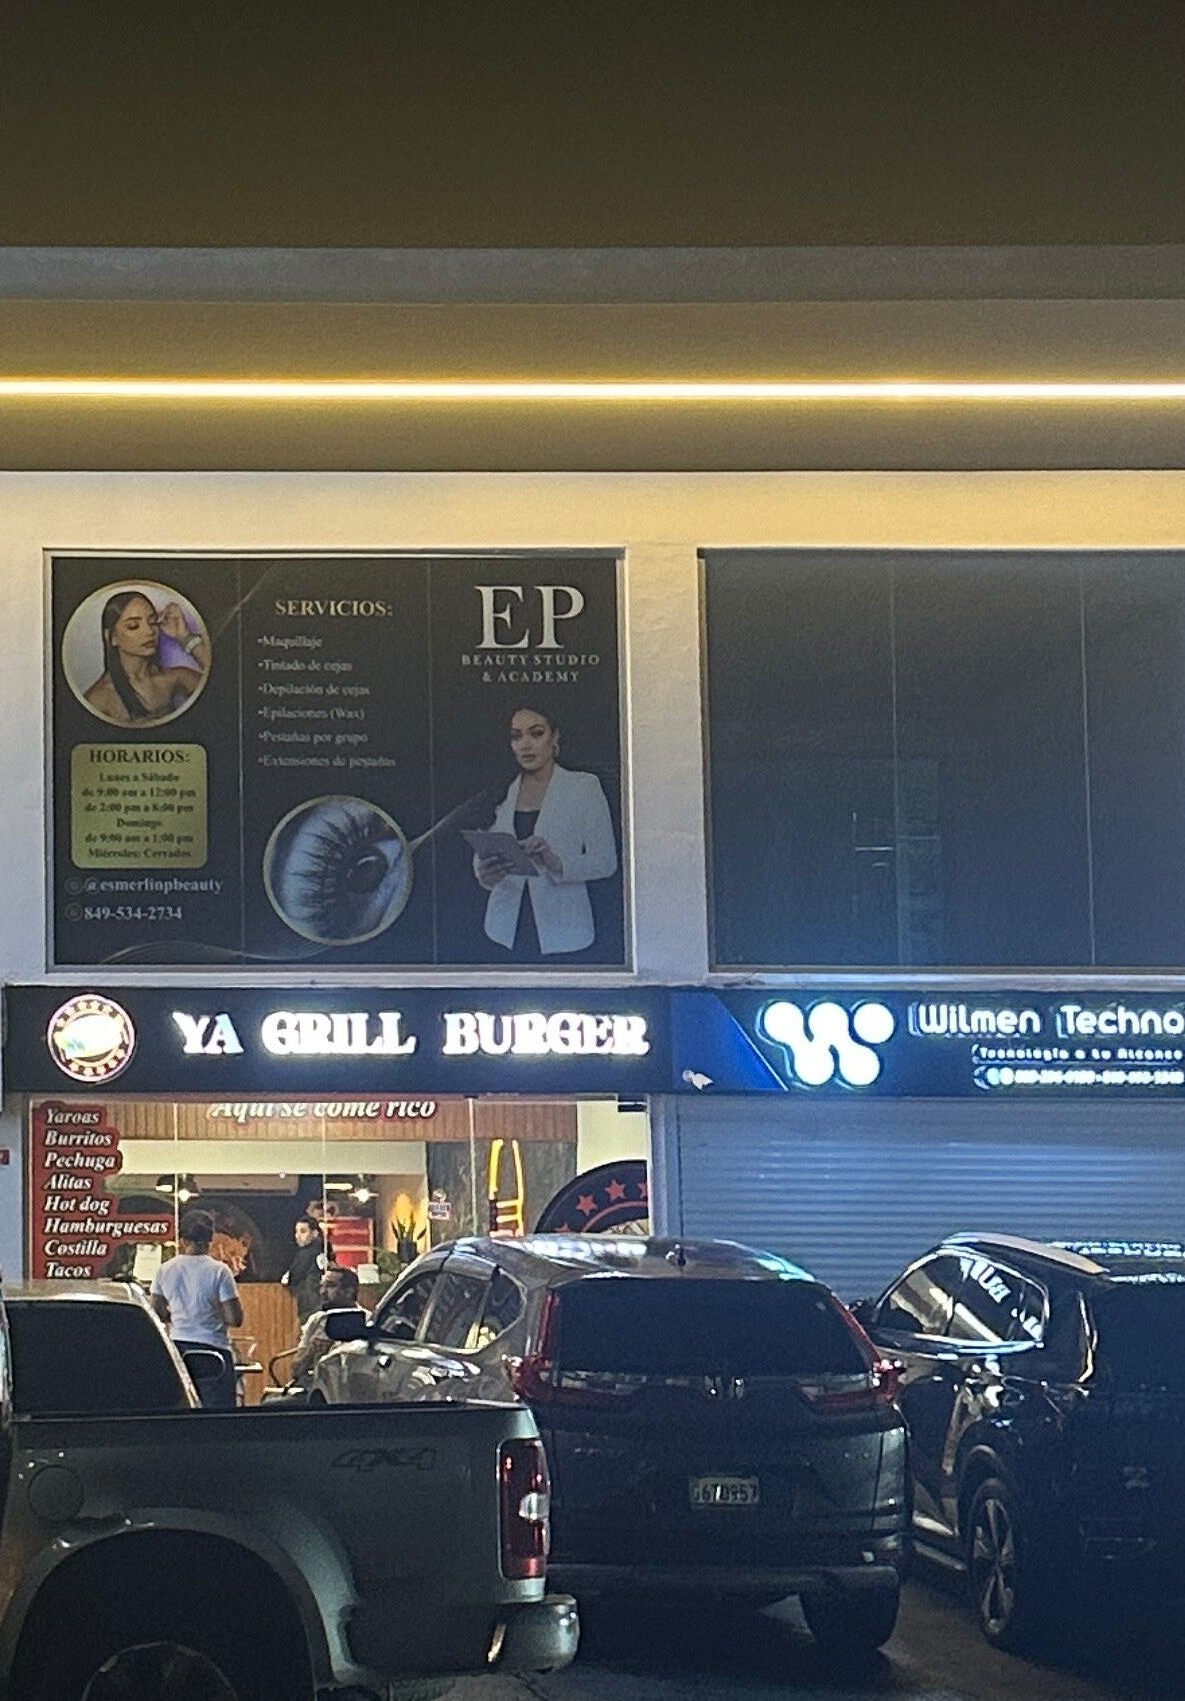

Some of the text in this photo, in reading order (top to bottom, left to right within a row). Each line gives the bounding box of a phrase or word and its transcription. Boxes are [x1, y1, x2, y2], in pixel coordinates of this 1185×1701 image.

[275, 600, 394, 617] SERVICIOS:
[473, 585, 585, 649] EP
[307, 659, 321, 671] de
[323, 661, 353, 674] cejas
[462, 654, 601, 666] BEAUTY STUDIO
[482, 671, 580, 683] & ACADEMY
[325, 683, 340, 695] de
[313, 732, 332, 745] por
[334, 733, 369, 745] grupo
[90, 749, 190, 764] HORARIOS:
[332, 755, 346, 767] de
[81, 788, 94, 797] de
[179, 789, 196, 800] pm
[84, 803, 98, 813] de
[123, 805, 141, 815] pm
[176, 805, 194, 815] pm
[84, 834, 97, 843] de
[176, 836, 194, 846] pm
[84, 878, 223, 895] @esmerlinpbeauty
[84, 906, 183, 920] 849-534-2734
[918, 1004, 1185, 1034] Wilmen Techno
[172, 1011, 650, 1055] YA GRILL BURGER
[46, 1108, 100, 1125] Yaroas
[279, 1102, 306, 1117] se
[314, 1102, 380, 1117] come
[386, 1101, 437, 1117] rico
[44, 1131, 112, 1147] Burritos
[44, 1151, 115, 1171] Pechuga
[43, 1174, 92, 1191] Alitas
[44, 1196, 110, 1215] Hot dog
[44, 1218, 169, 1237] Hamburguesas
[44, 1240, 108, 1257] Costilla
[46, 1262, 92, 1278] Tacos
